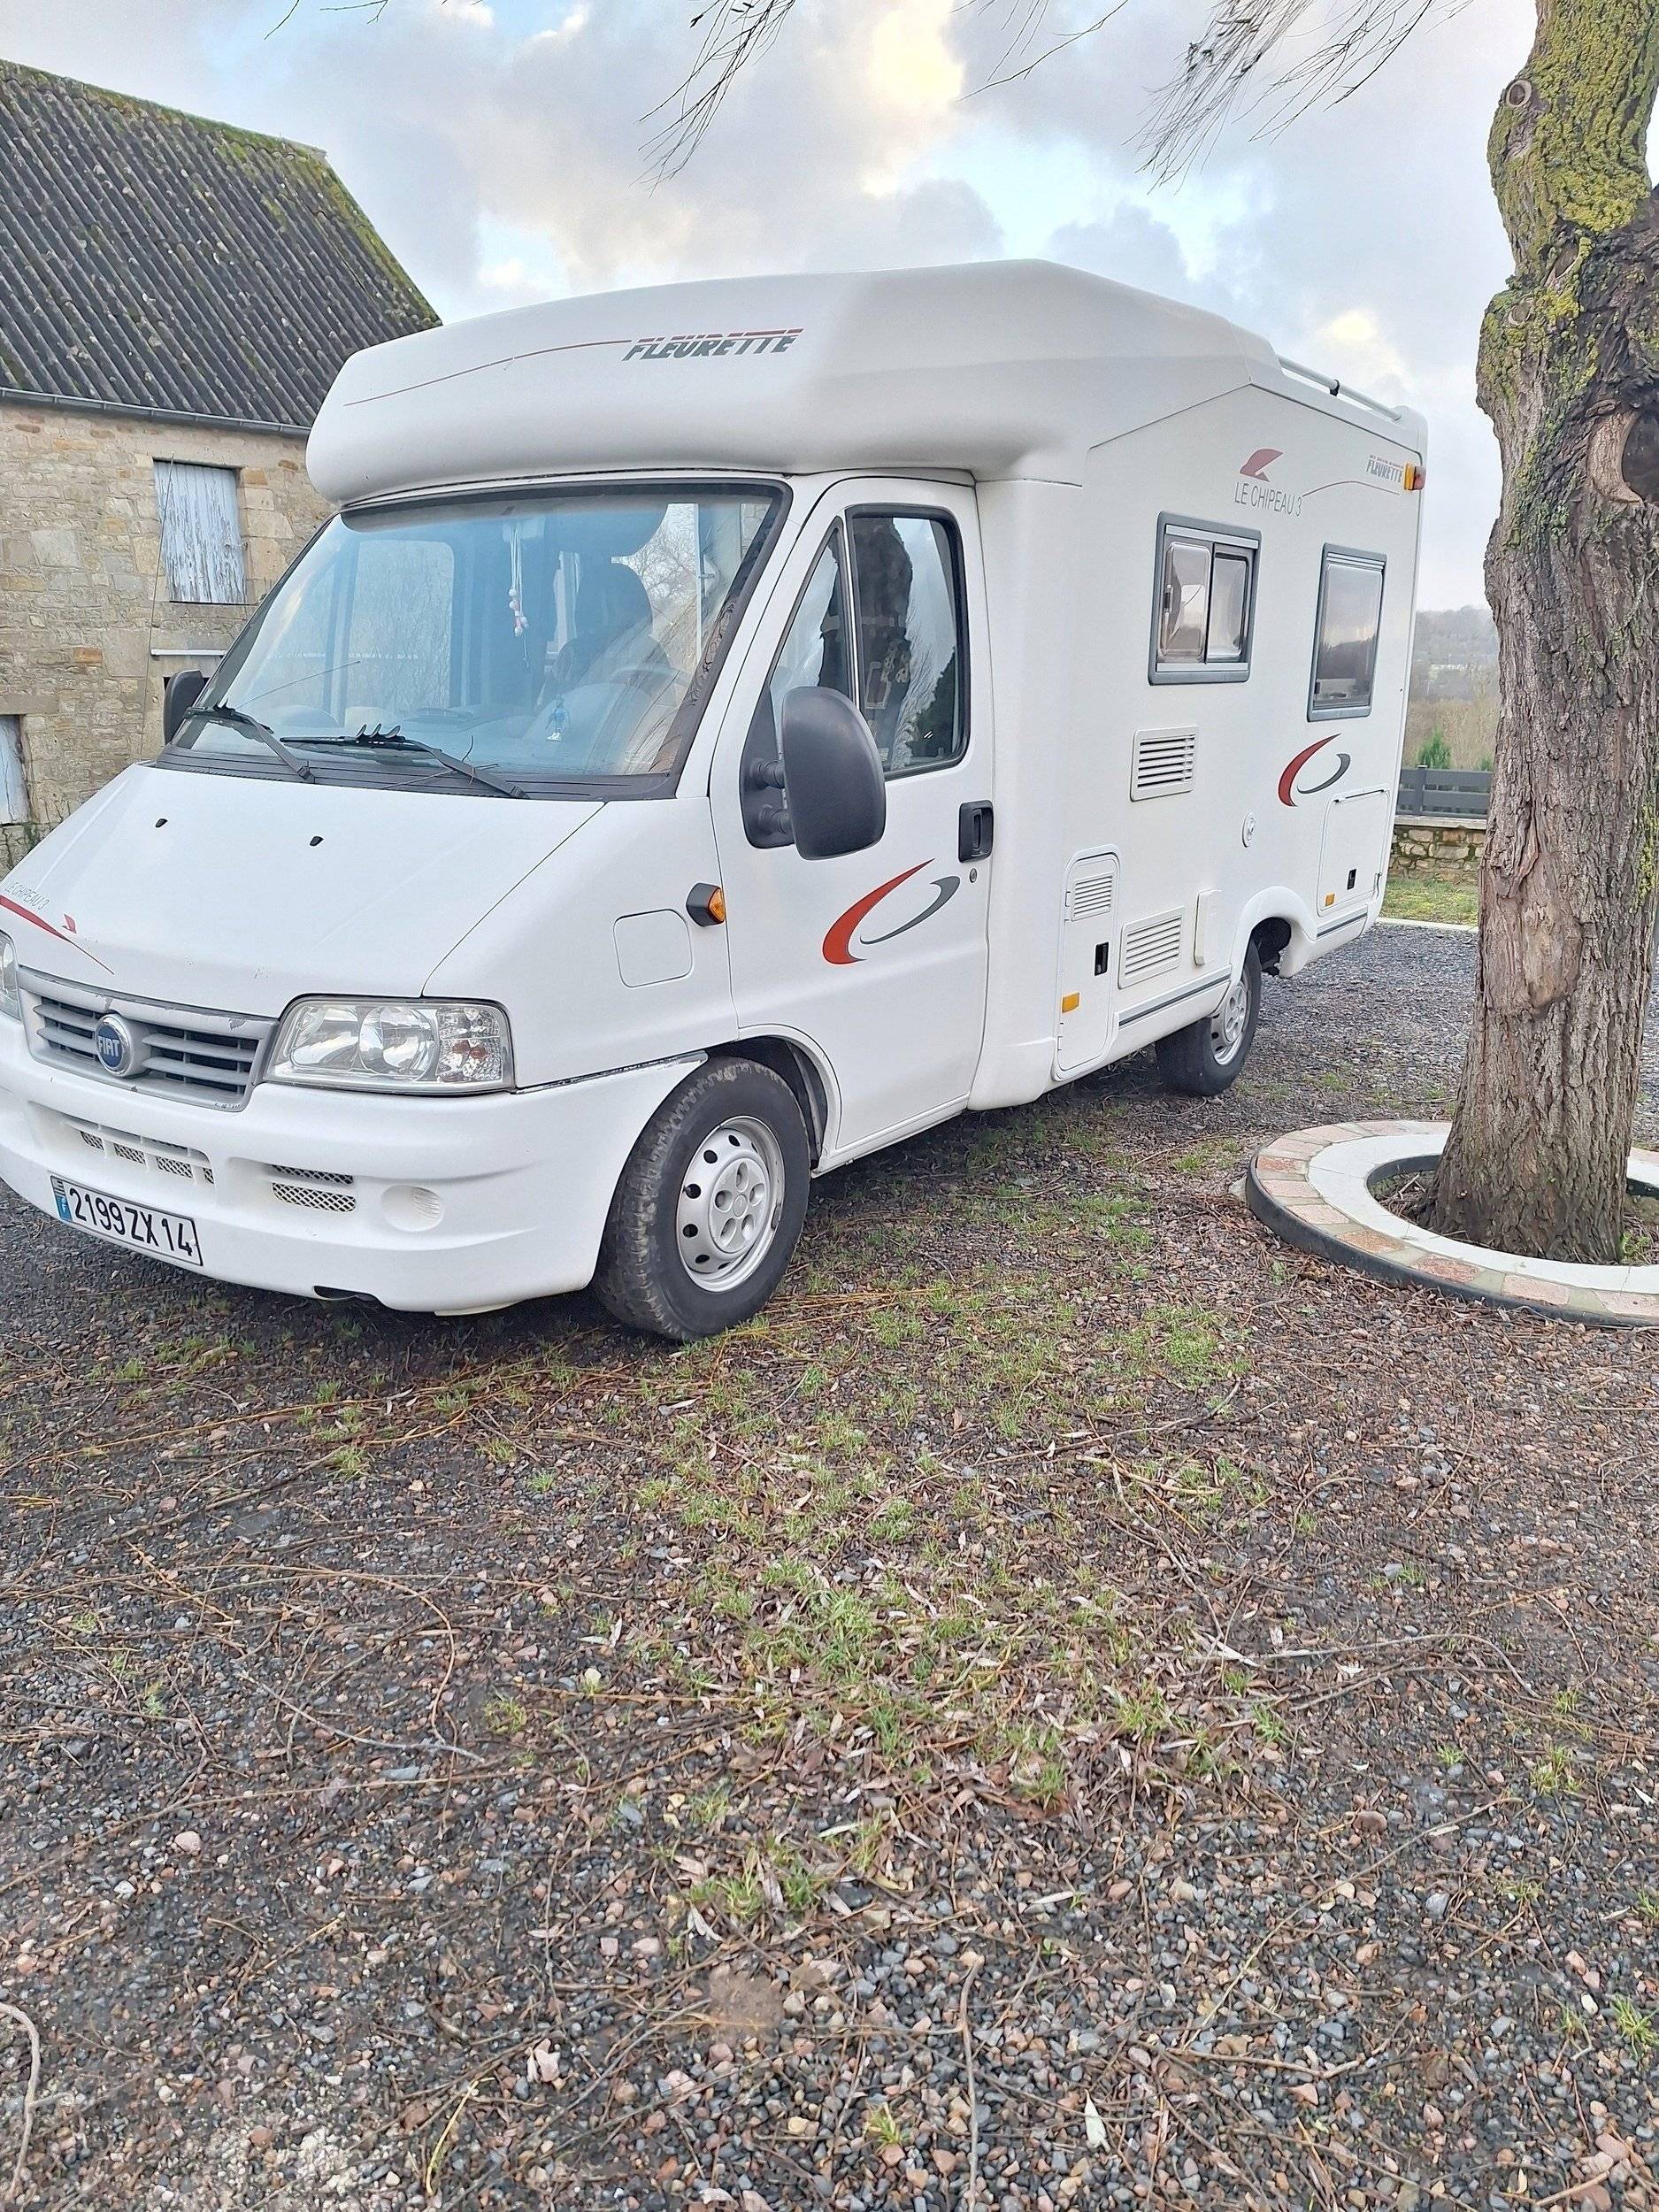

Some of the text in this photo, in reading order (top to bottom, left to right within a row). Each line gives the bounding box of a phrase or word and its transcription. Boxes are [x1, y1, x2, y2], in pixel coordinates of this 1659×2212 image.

[621, 334, 800, 362] FLEURETTE
[1366, 458, 1404, 483] FLEURETTE
[1233, 481, 1302, 518] LE CHIPEAU 3
[97, 1035, 120, 1057] FIAT
